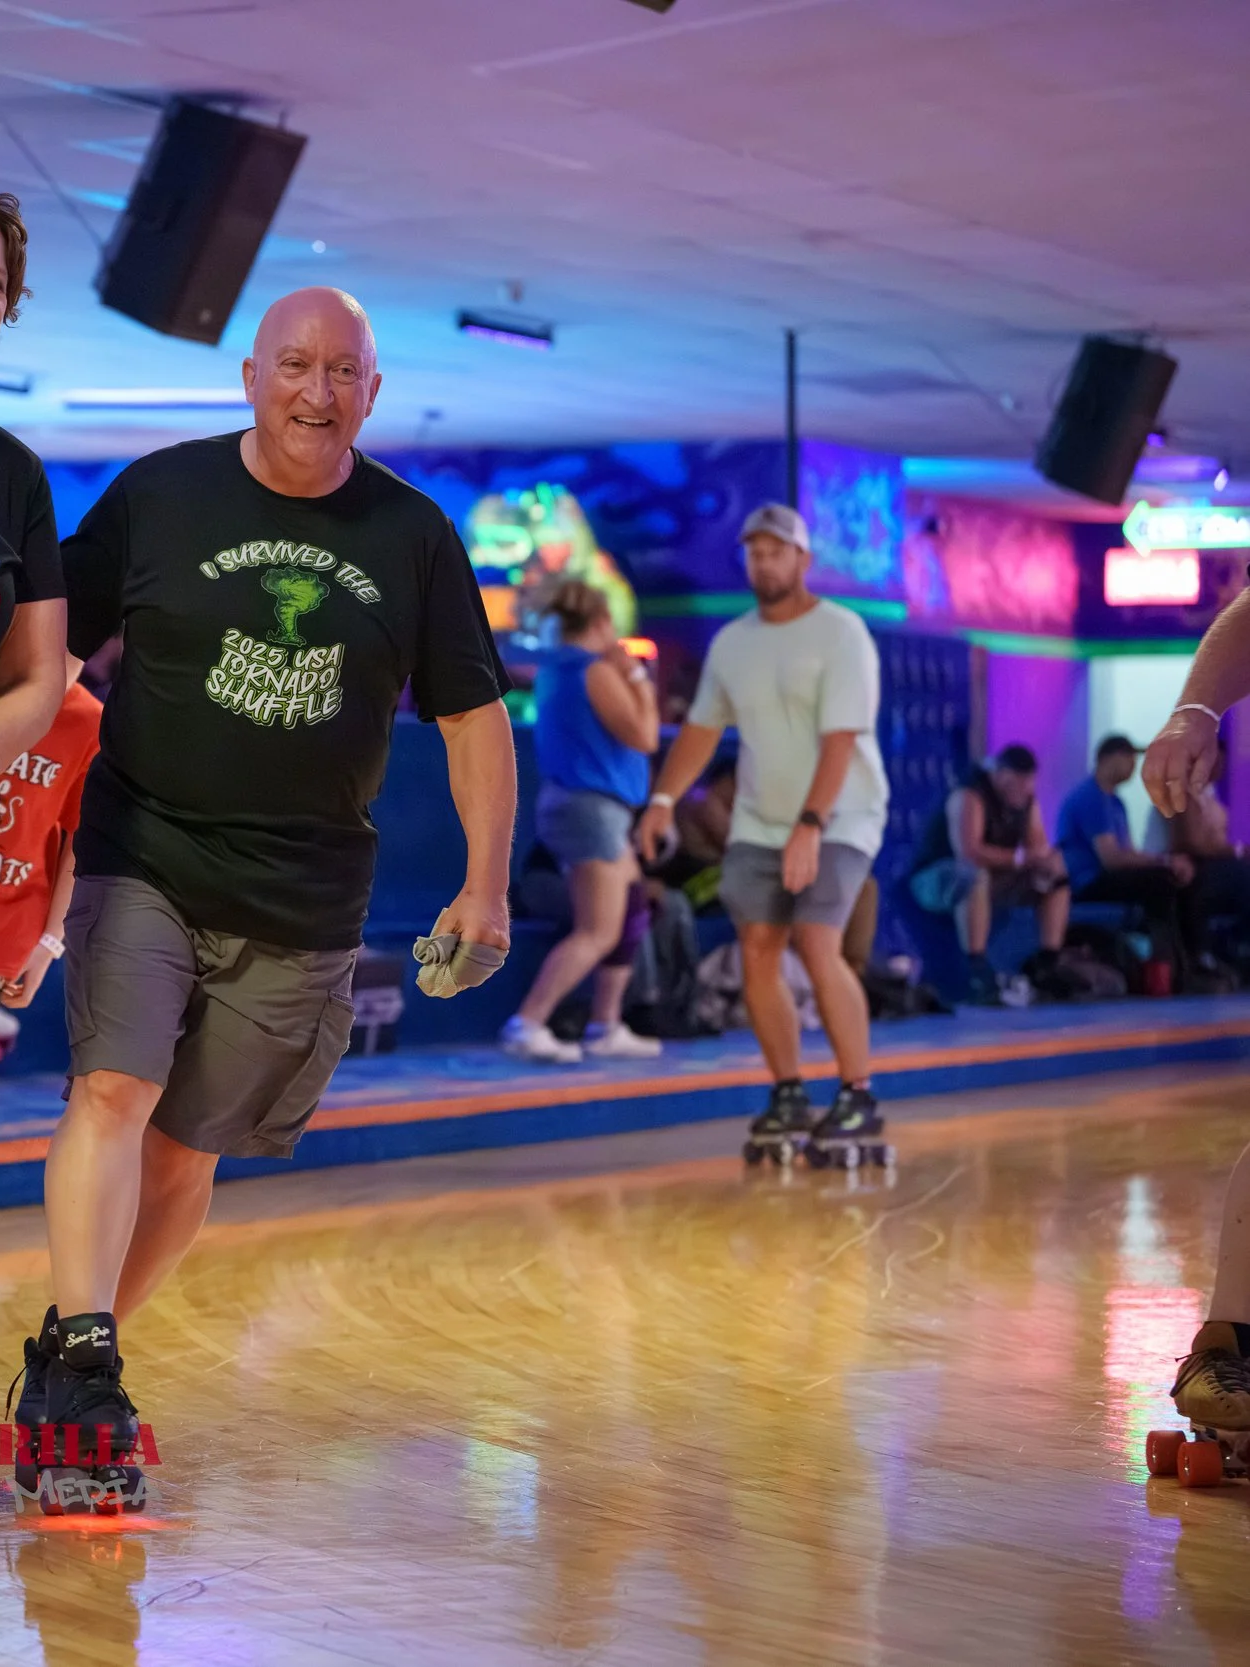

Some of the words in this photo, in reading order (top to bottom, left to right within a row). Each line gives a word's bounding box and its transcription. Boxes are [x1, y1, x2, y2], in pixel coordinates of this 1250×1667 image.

[200, 561, 220, 581] I
[214, 540, 337, 571] SURVIVED
[334, 561, 382, 604] THE
[219, 647, 340, 696] TORNADO
[222, 628, 288, 670] 2025
[293, 643, 345, 670] USA
[206, 668, 343, 729] SHUFFLE
[6, 752, 62, 788] ATE
